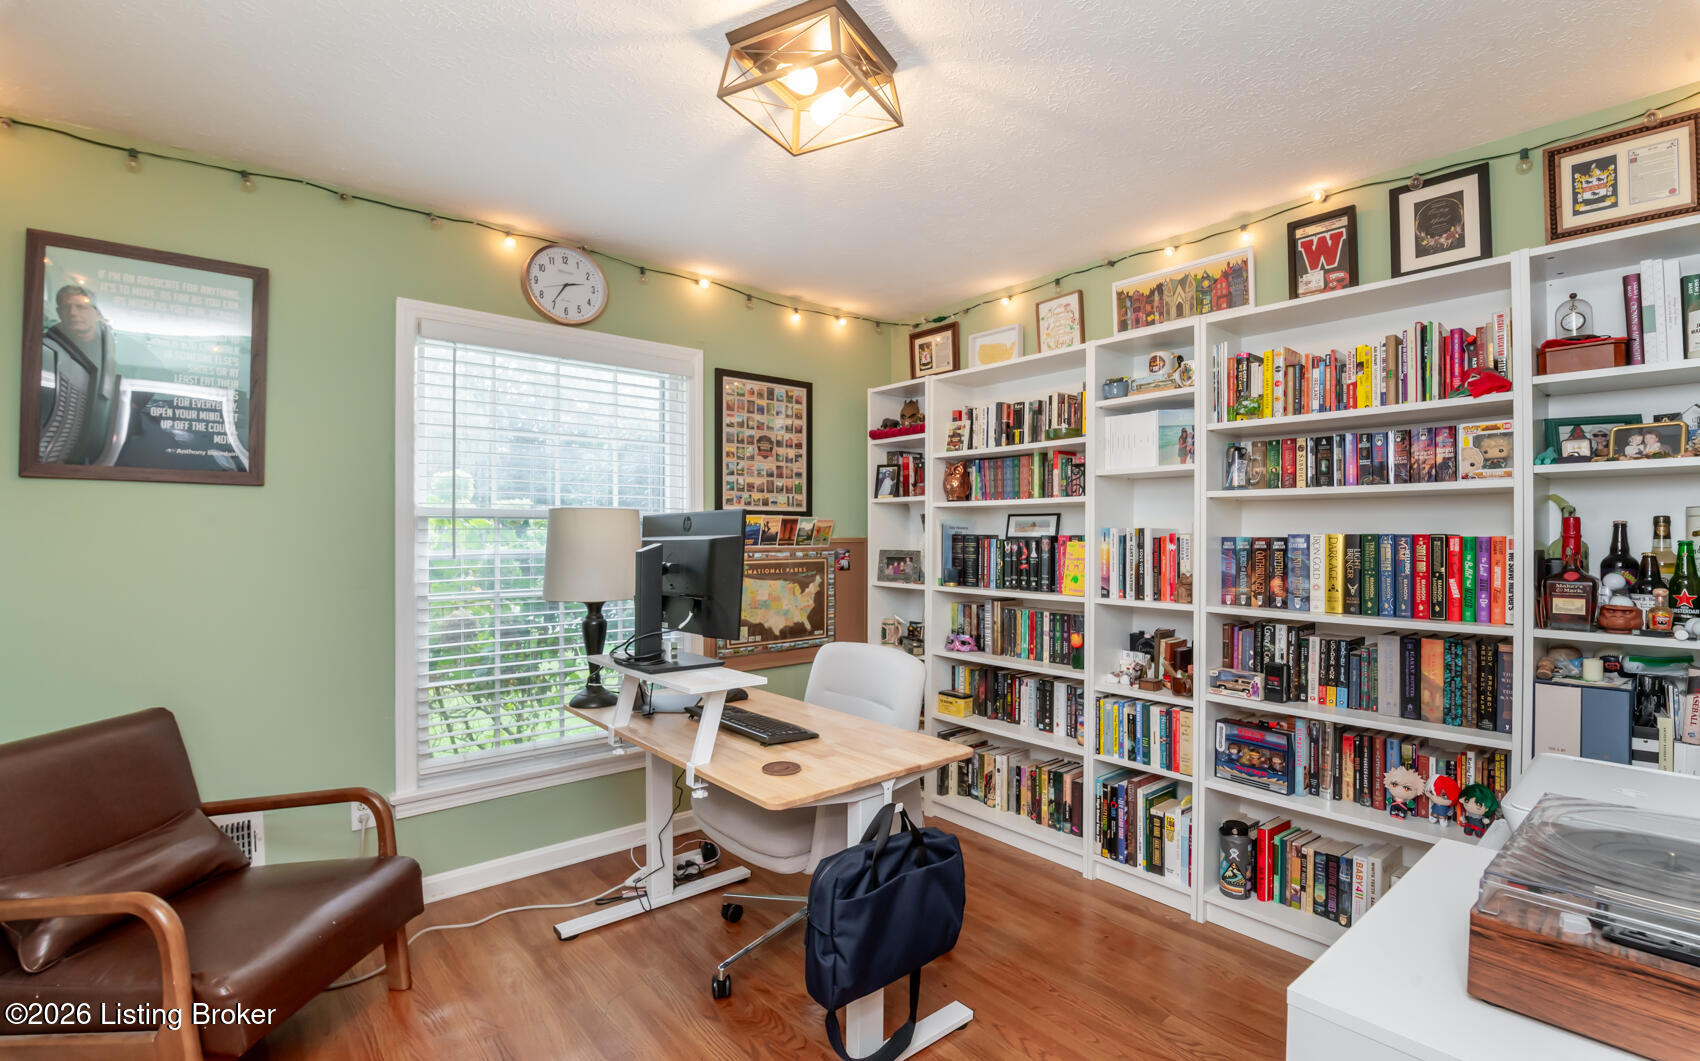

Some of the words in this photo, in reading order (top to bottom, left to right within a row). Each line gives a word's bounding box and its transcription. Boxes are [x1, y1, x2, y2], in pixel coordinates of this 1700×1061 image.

[1298, 228, 1346, 273] W
[548, 256, 555, 266] 11
[561, 256, 568, 264] 12
[538, 264, 546, 272] 10
[576, 262, 580, 270] 1
[534, 276, 538, 284] 9
[586, 272, 590, 280] 2
[539, 290, 544, 299] 8
[591, 286, 596, 294] 3
[586, 298, 592, 306] 4
[564, 306, 568, 316] 6
[576, 305, 582, 314] 5
[1632, 331, 1640, 360] MIDNIGHT
[174, 374, 199, 384] LEAST
[174, 397, 190, 407] FOR
[150, 406, 173, 418] OPEN
[174, 409, 198, 420] YOUR
[160, 419, 173, 430] UP
[174, 420, 190, 430] OFF
[192, 421, 207, 432] THE
[1312, 536, 1321, 556] IRON
[1327, 537, 1338, 560] DARK
[1399, 538, 1407, 560] YUMI
[1293, 550, 1302, 567] WIND
[1509, 553, 1514, 562] We
[1274, 551, 1283, 576] RHYTHM
[1312, 556, 1322, 580] GOLD
[1256, 550, 1265, 593] OATHBRINGER
[1328, 563, 1338, 581] AGE
[1465, 561, 1473, 578] Bullet
[1480, 564, 1488, 576] Last
[1480, 599, 1488, 607] Die
